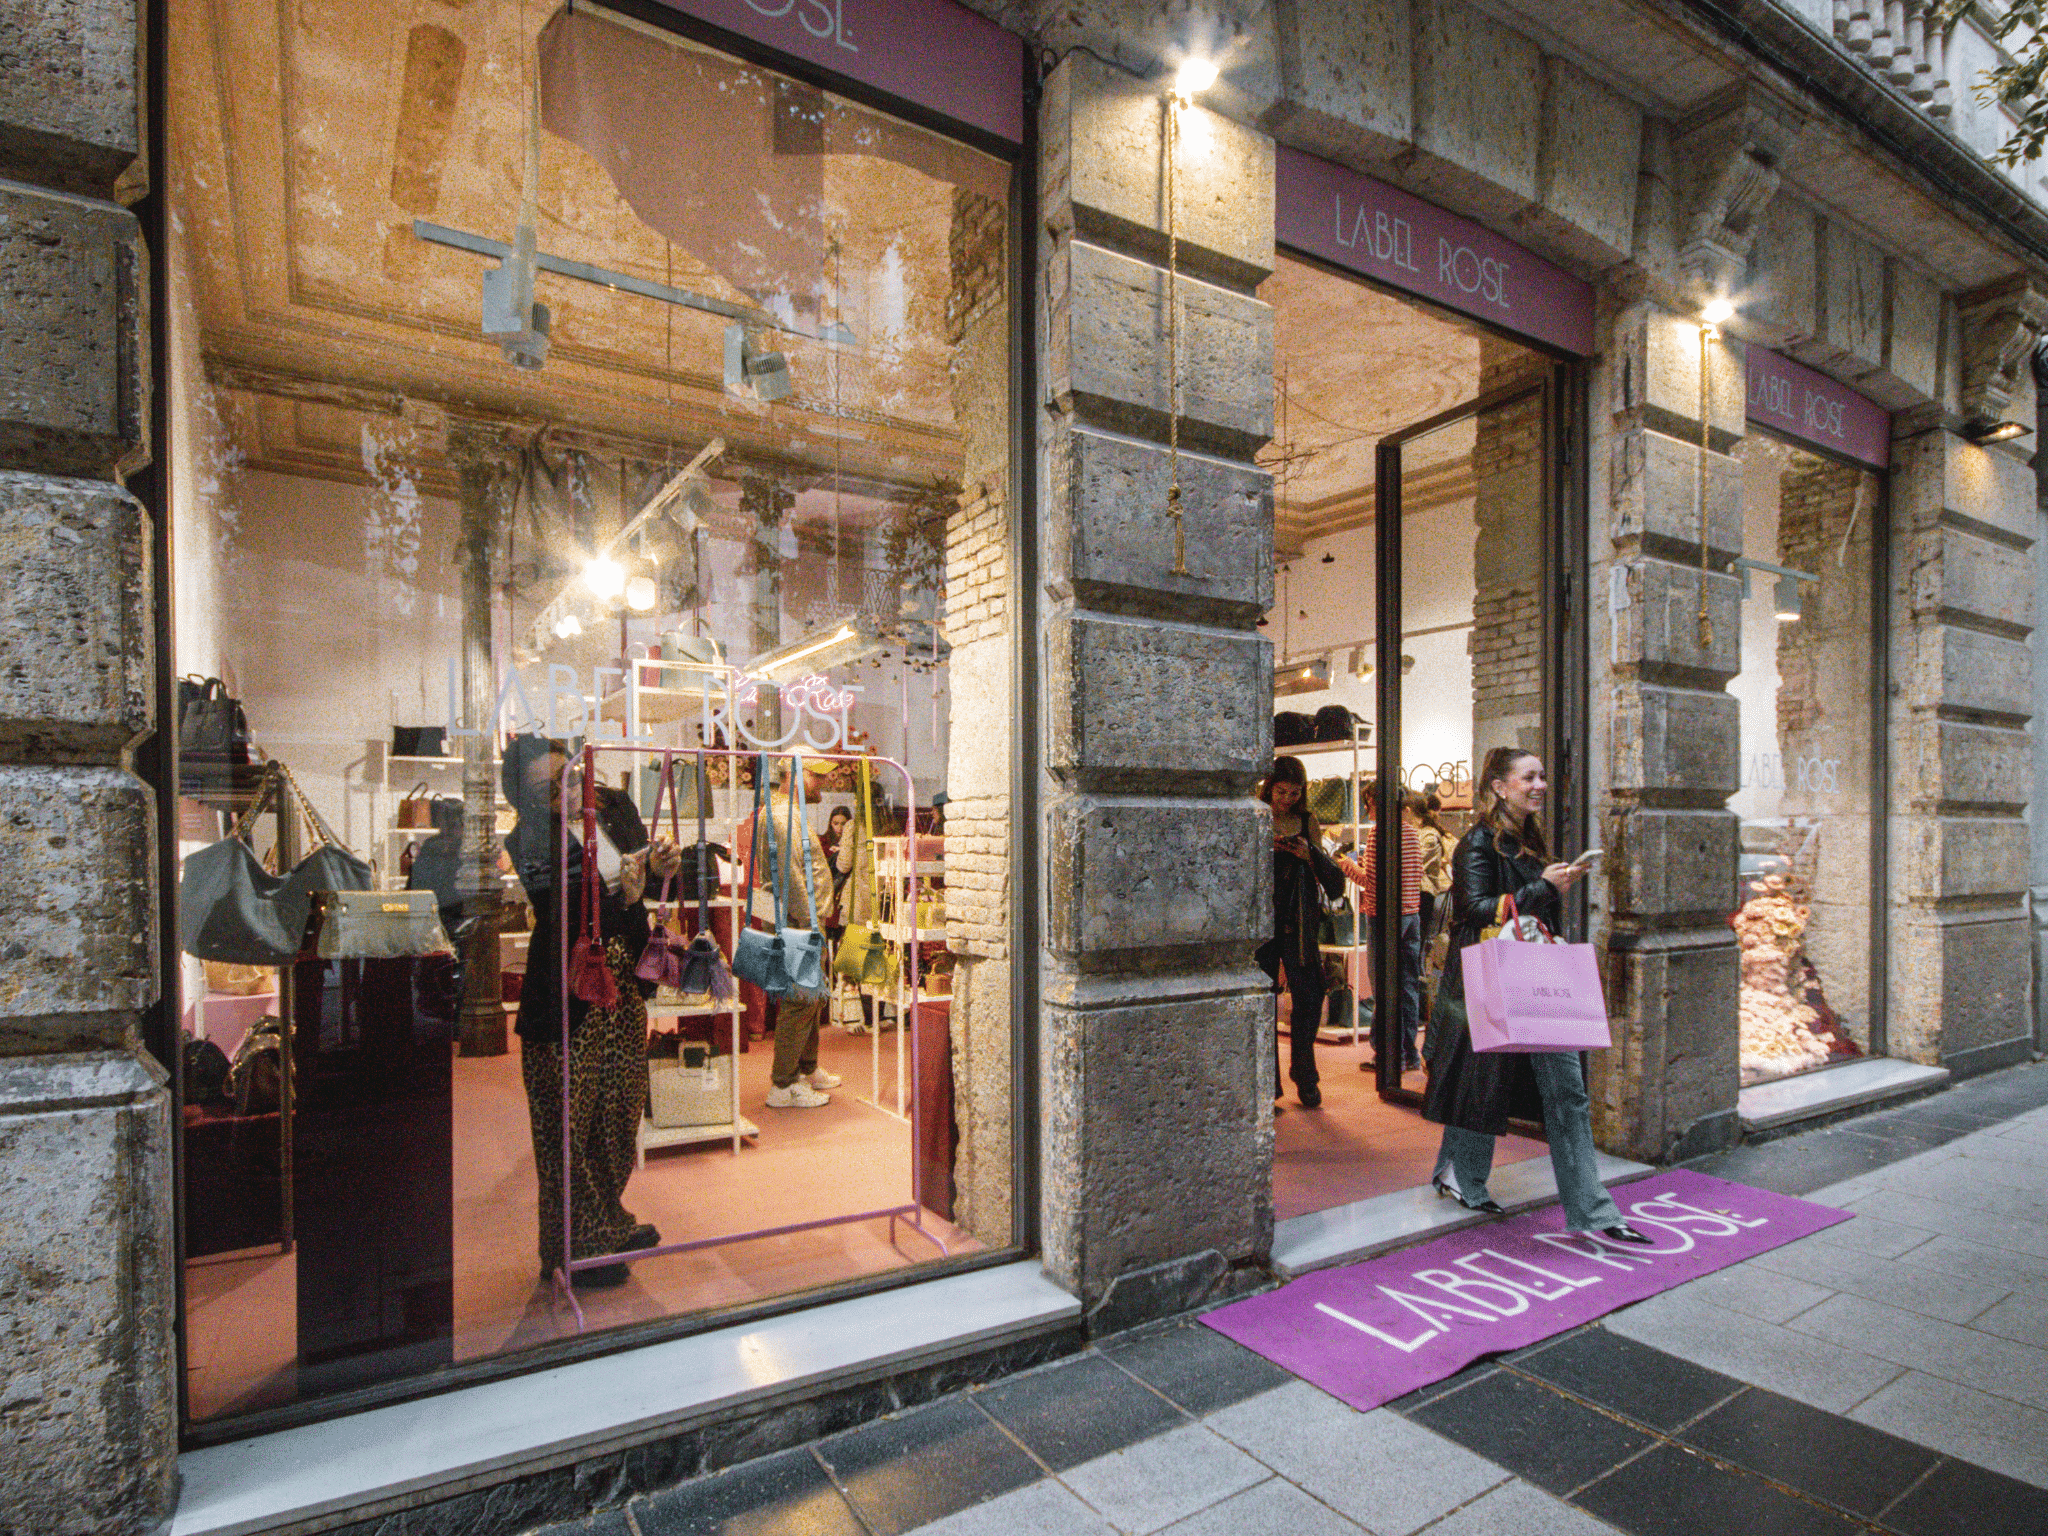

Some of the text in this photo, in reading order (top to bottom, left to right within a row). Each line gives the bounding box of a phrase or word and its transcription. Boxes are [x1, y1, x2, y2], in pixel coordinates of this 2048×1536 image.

[745, 0, 859, 52] SE
[1336, 194, 1511, 309] LABEL ROSE
[1748, 368, 1846, 439] LABEL ROSE
[447, 657, 654, 742] LABEL
[702, 673, 866, 752] ROSE
[1396, 759, 1468, 801] ROSE
[1797, 756, 1841, 794] ROSE
[1313, 1192, 1770, 1354] LABEL ROSE
